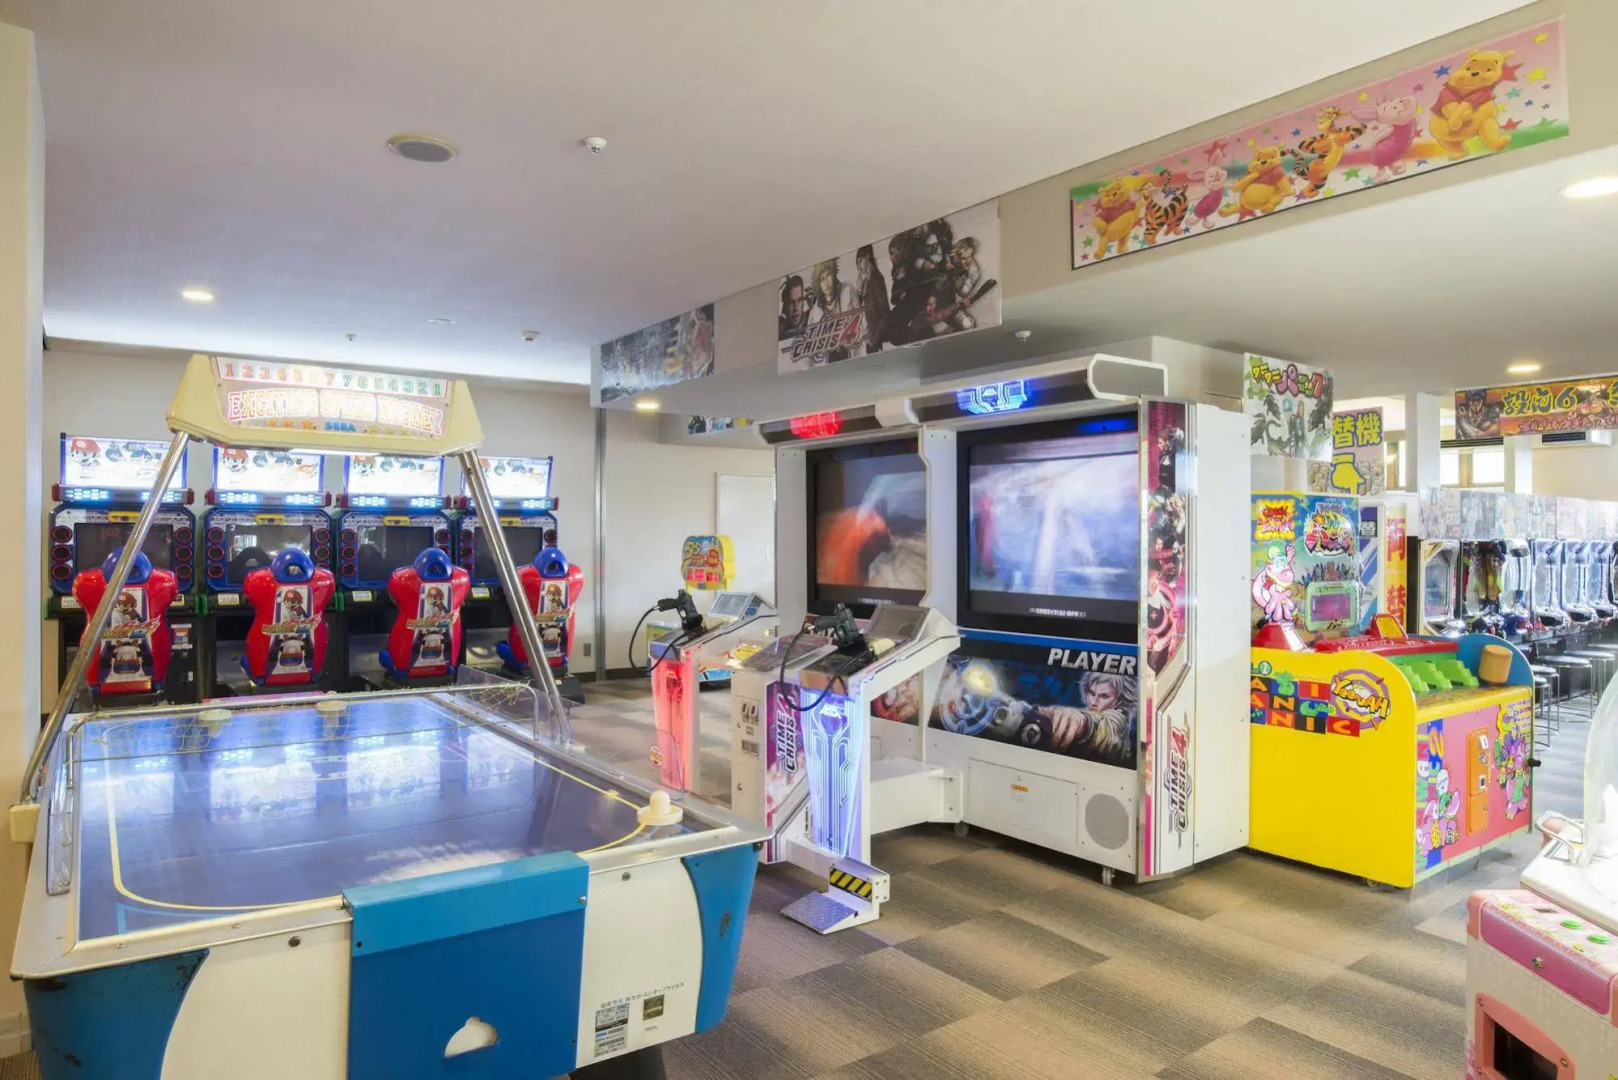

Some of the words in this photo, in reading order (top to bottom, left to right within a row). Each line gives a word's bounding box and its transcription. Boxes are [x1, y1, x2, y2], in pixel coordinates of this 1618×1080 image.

[792, 334, 838, 359] CRISIS
[839, 315, 862, 343] 4
[808, 319, 846, 339] TIME
[1047, 647, 1137, 675] PLAYER
[777, 711, 786, 755] TIME
[786, 717, 796, 771] CRISIS
[1170, 754, 1180, 809] TIME
[1178, 760, 1187, 829] CRISIS
